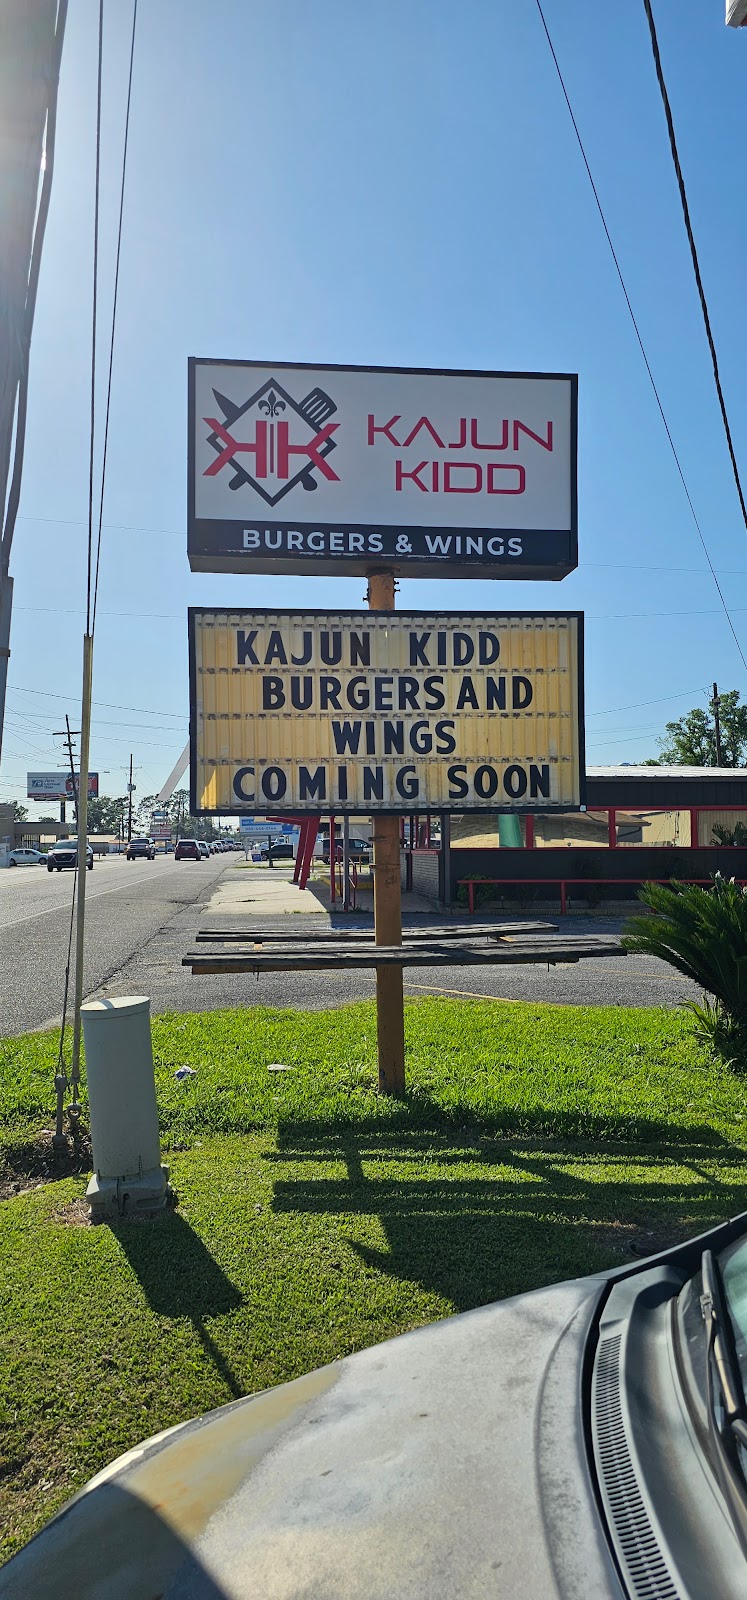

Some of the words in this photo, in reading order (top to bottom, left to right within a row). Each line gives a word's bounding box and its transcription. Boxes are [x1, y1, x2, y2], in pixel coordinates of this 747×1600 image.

[367, 414, 553, 452] KAJUN
[395, 460, 526, 495] KIDD
[242, 529, 384, 553] BURGERS
[395, 533, 413, 554] &
[424, 535, 524, 557] WINGS
[236, 630, 371, 666] KAJUN
[408, 631, 500, 667] KIDD
[261, 675, 446, 711] BURGERS
[456, 675, 534, 710] AND
[331, 719, 457, 755] WINGS
[232, 765, 420, 801] COMING
[447, 764, 550, 799] SOON
